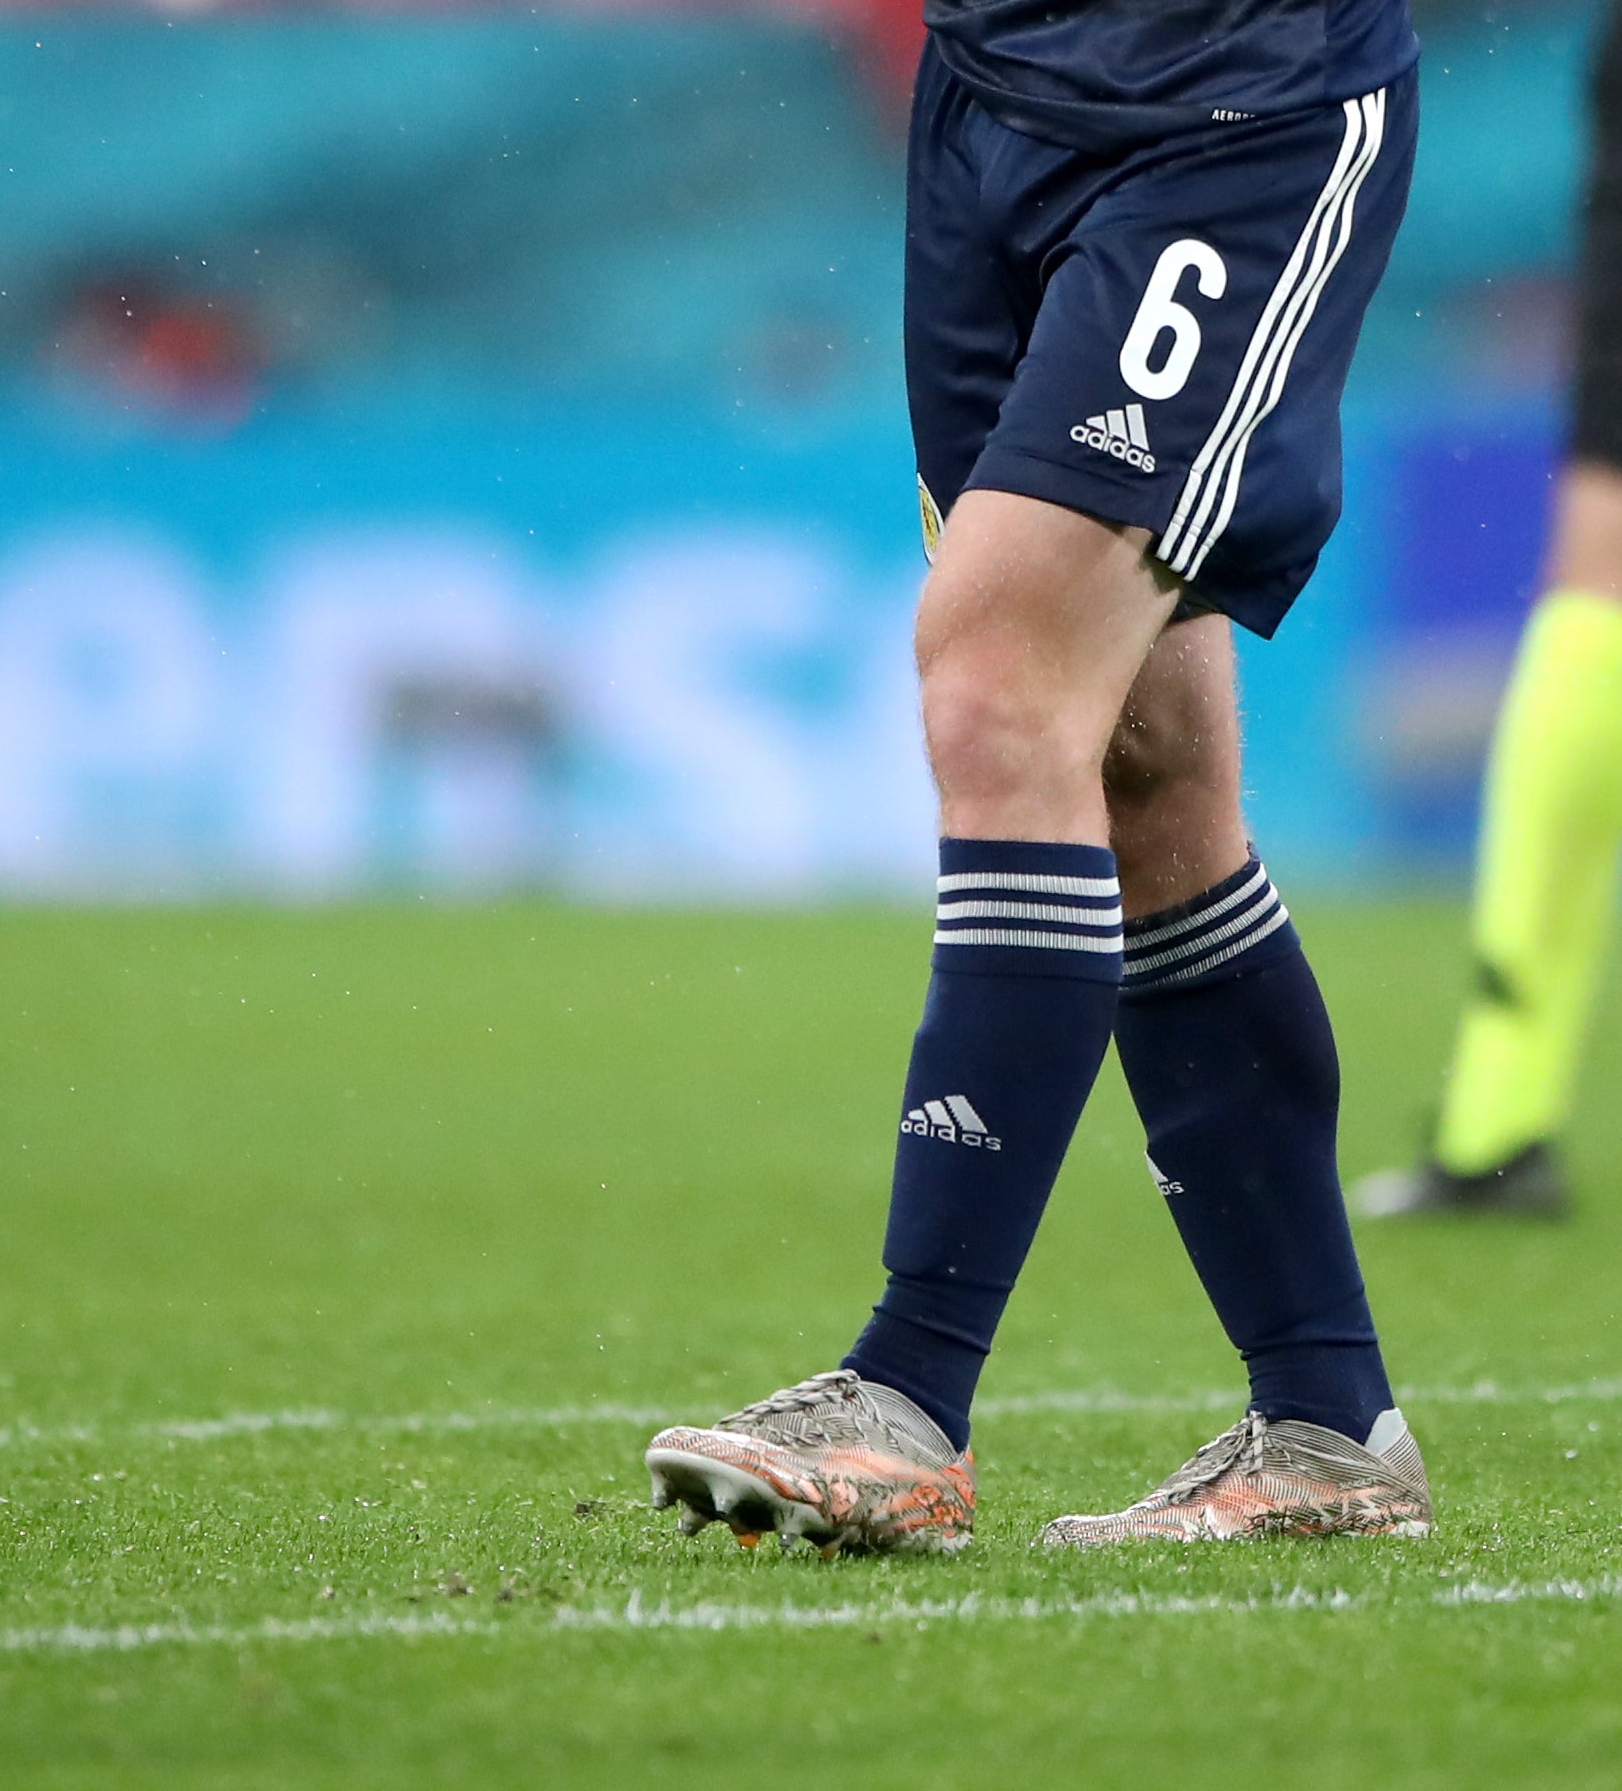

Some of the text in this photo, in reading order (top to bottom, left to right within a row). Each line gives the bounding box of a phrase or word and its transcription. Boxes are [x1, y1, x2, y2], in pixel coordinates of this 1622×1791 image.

[1119, 239, 1227, 400] 6
[1070, 425, 1155, 473] adidas
[900, 1119, 1002, 1152] adidas
